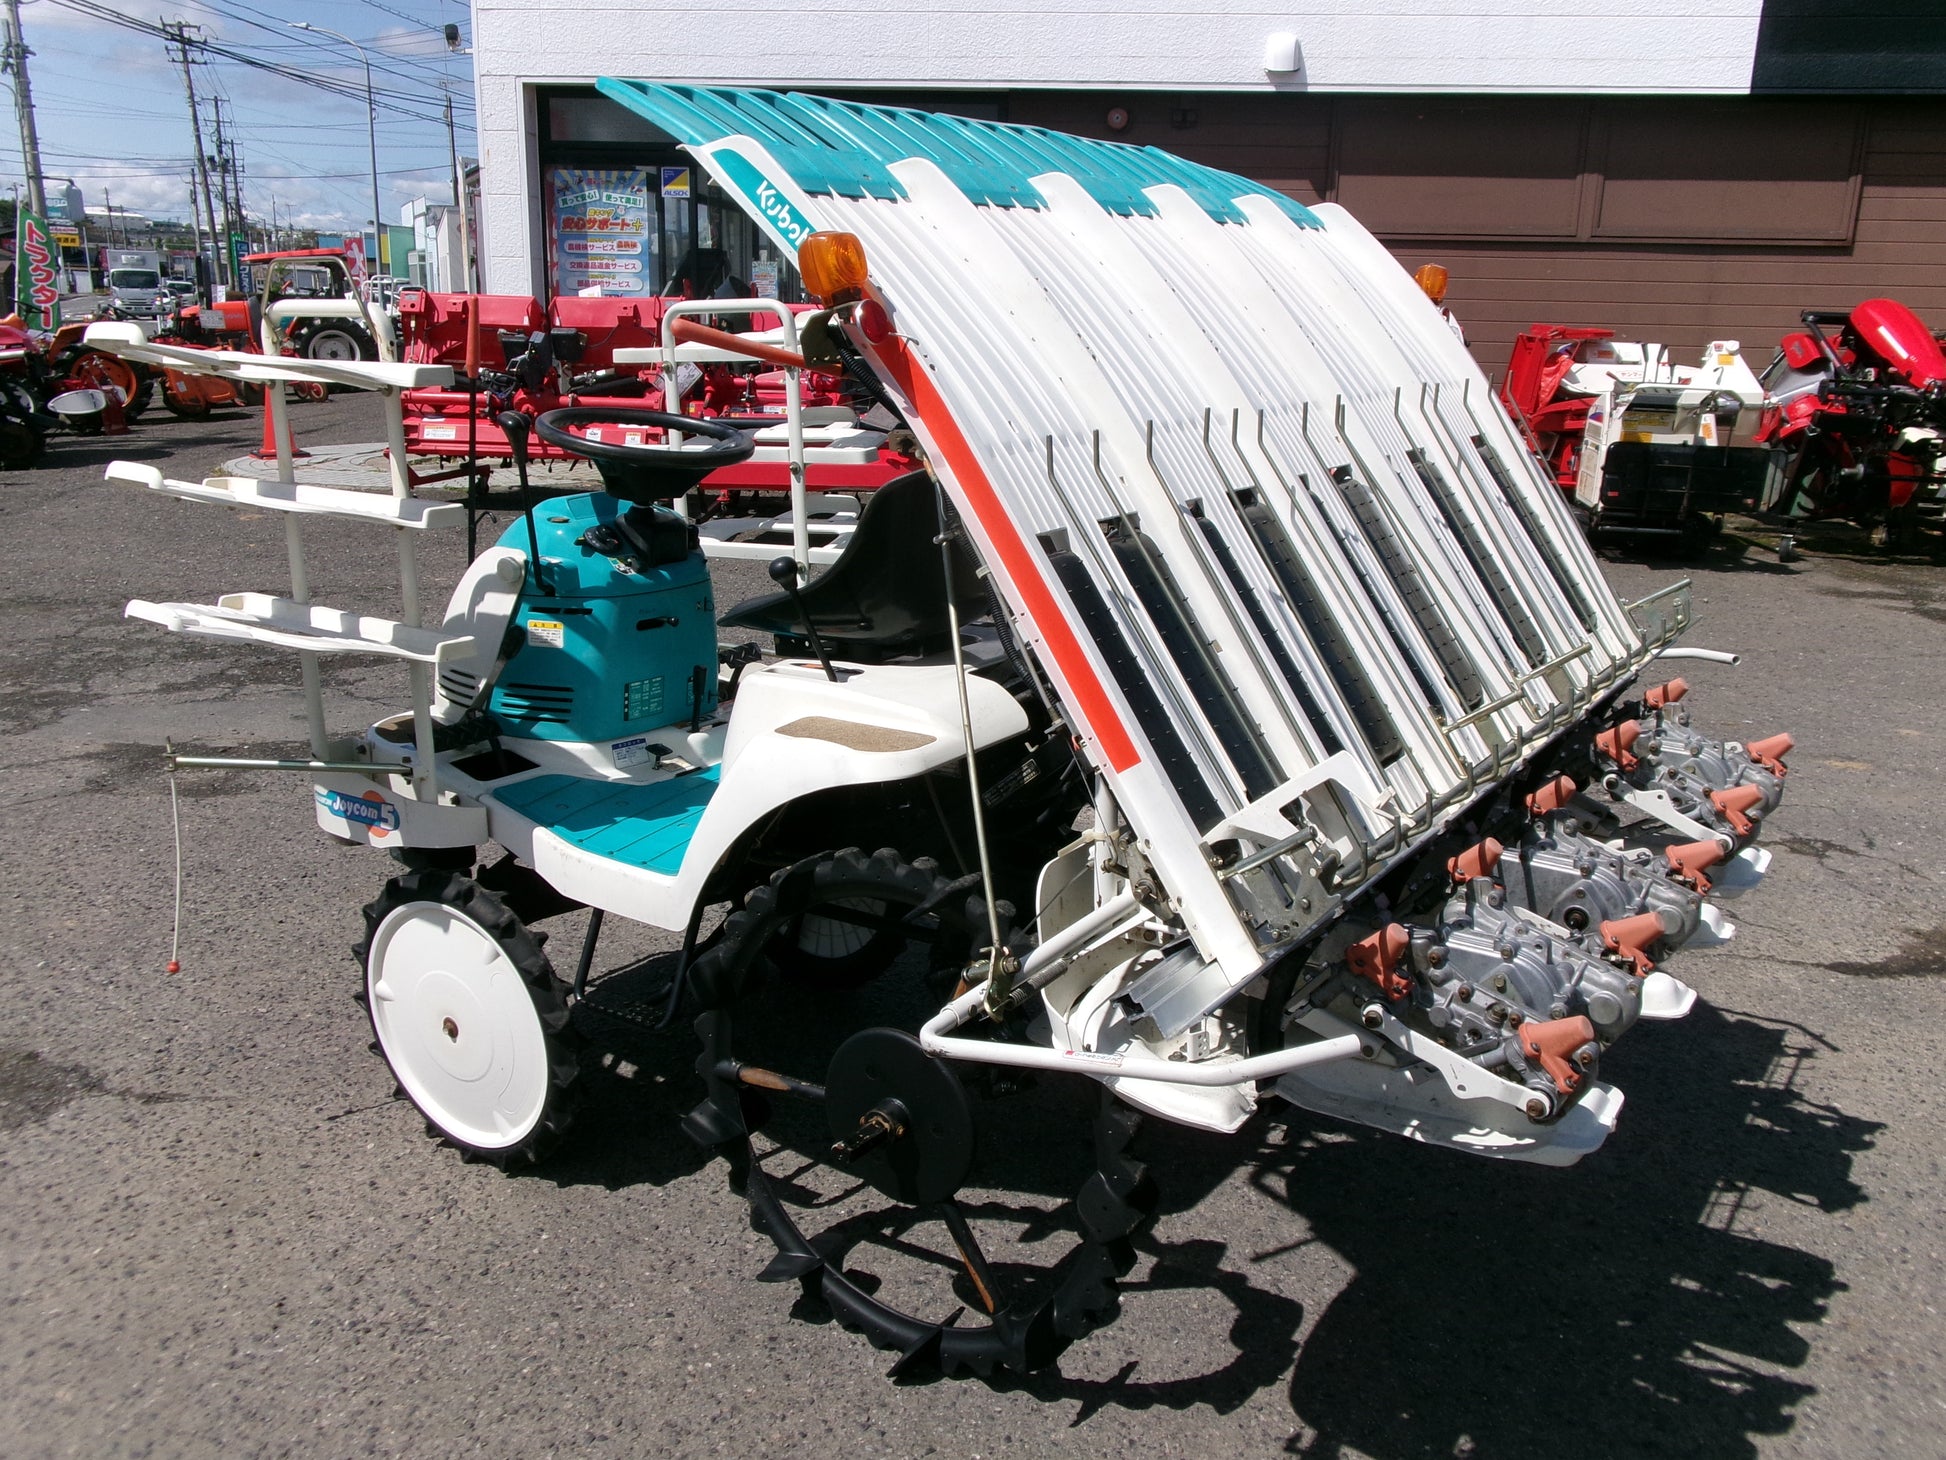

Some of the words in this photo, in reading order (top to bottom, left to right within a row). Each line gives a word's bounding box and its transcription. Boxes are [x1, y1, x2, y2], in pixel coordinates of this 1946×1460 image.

[756, 179, 810, 247] Kubot
[25, 220, 59, 329] トラクター
[333, 796, 378, 819] Joycom
[381, 803, 395, 831] 5
